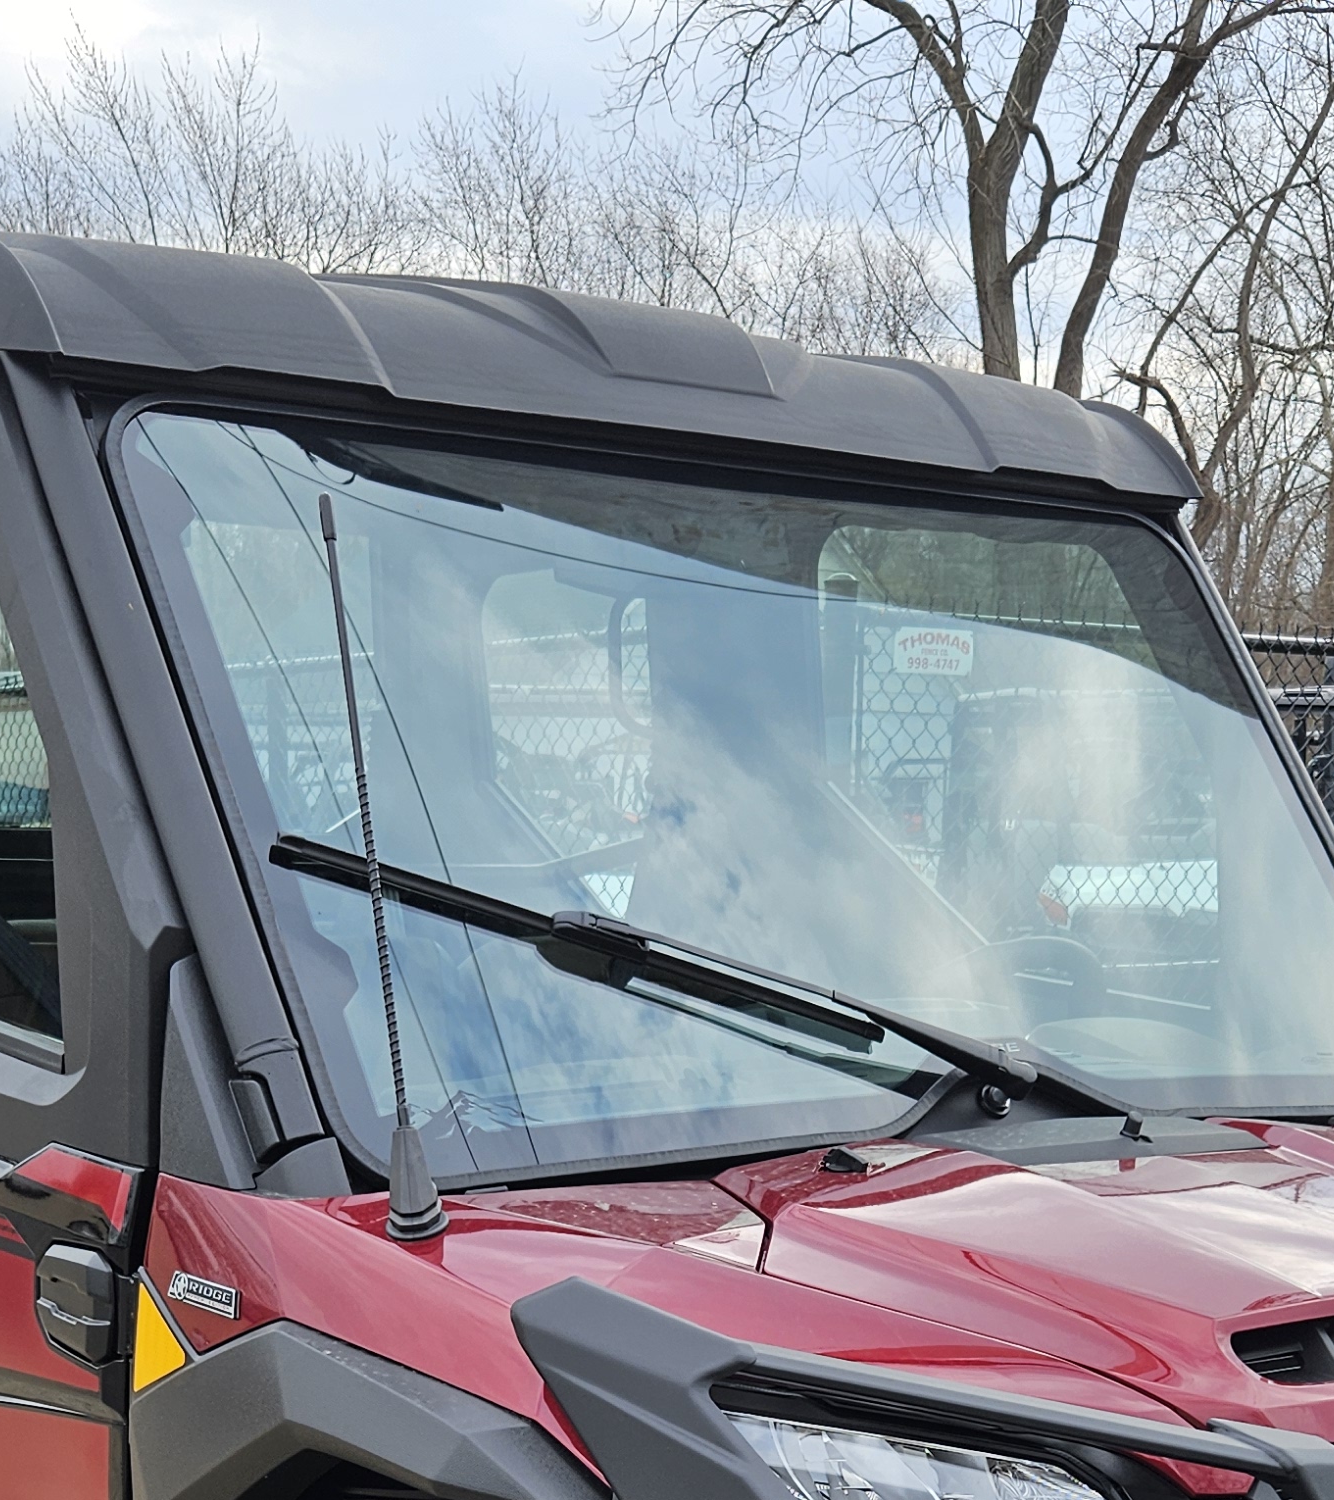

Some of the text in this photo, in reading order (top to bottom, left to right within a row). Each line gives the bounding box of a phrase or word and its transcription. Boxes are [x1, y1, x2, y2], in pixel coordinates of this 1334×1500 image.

[898, 632, 970, 655] THOMAS
[907, 657, 960, 671] 998-4747
[189, 1281, 232, 1304] RIDGE
